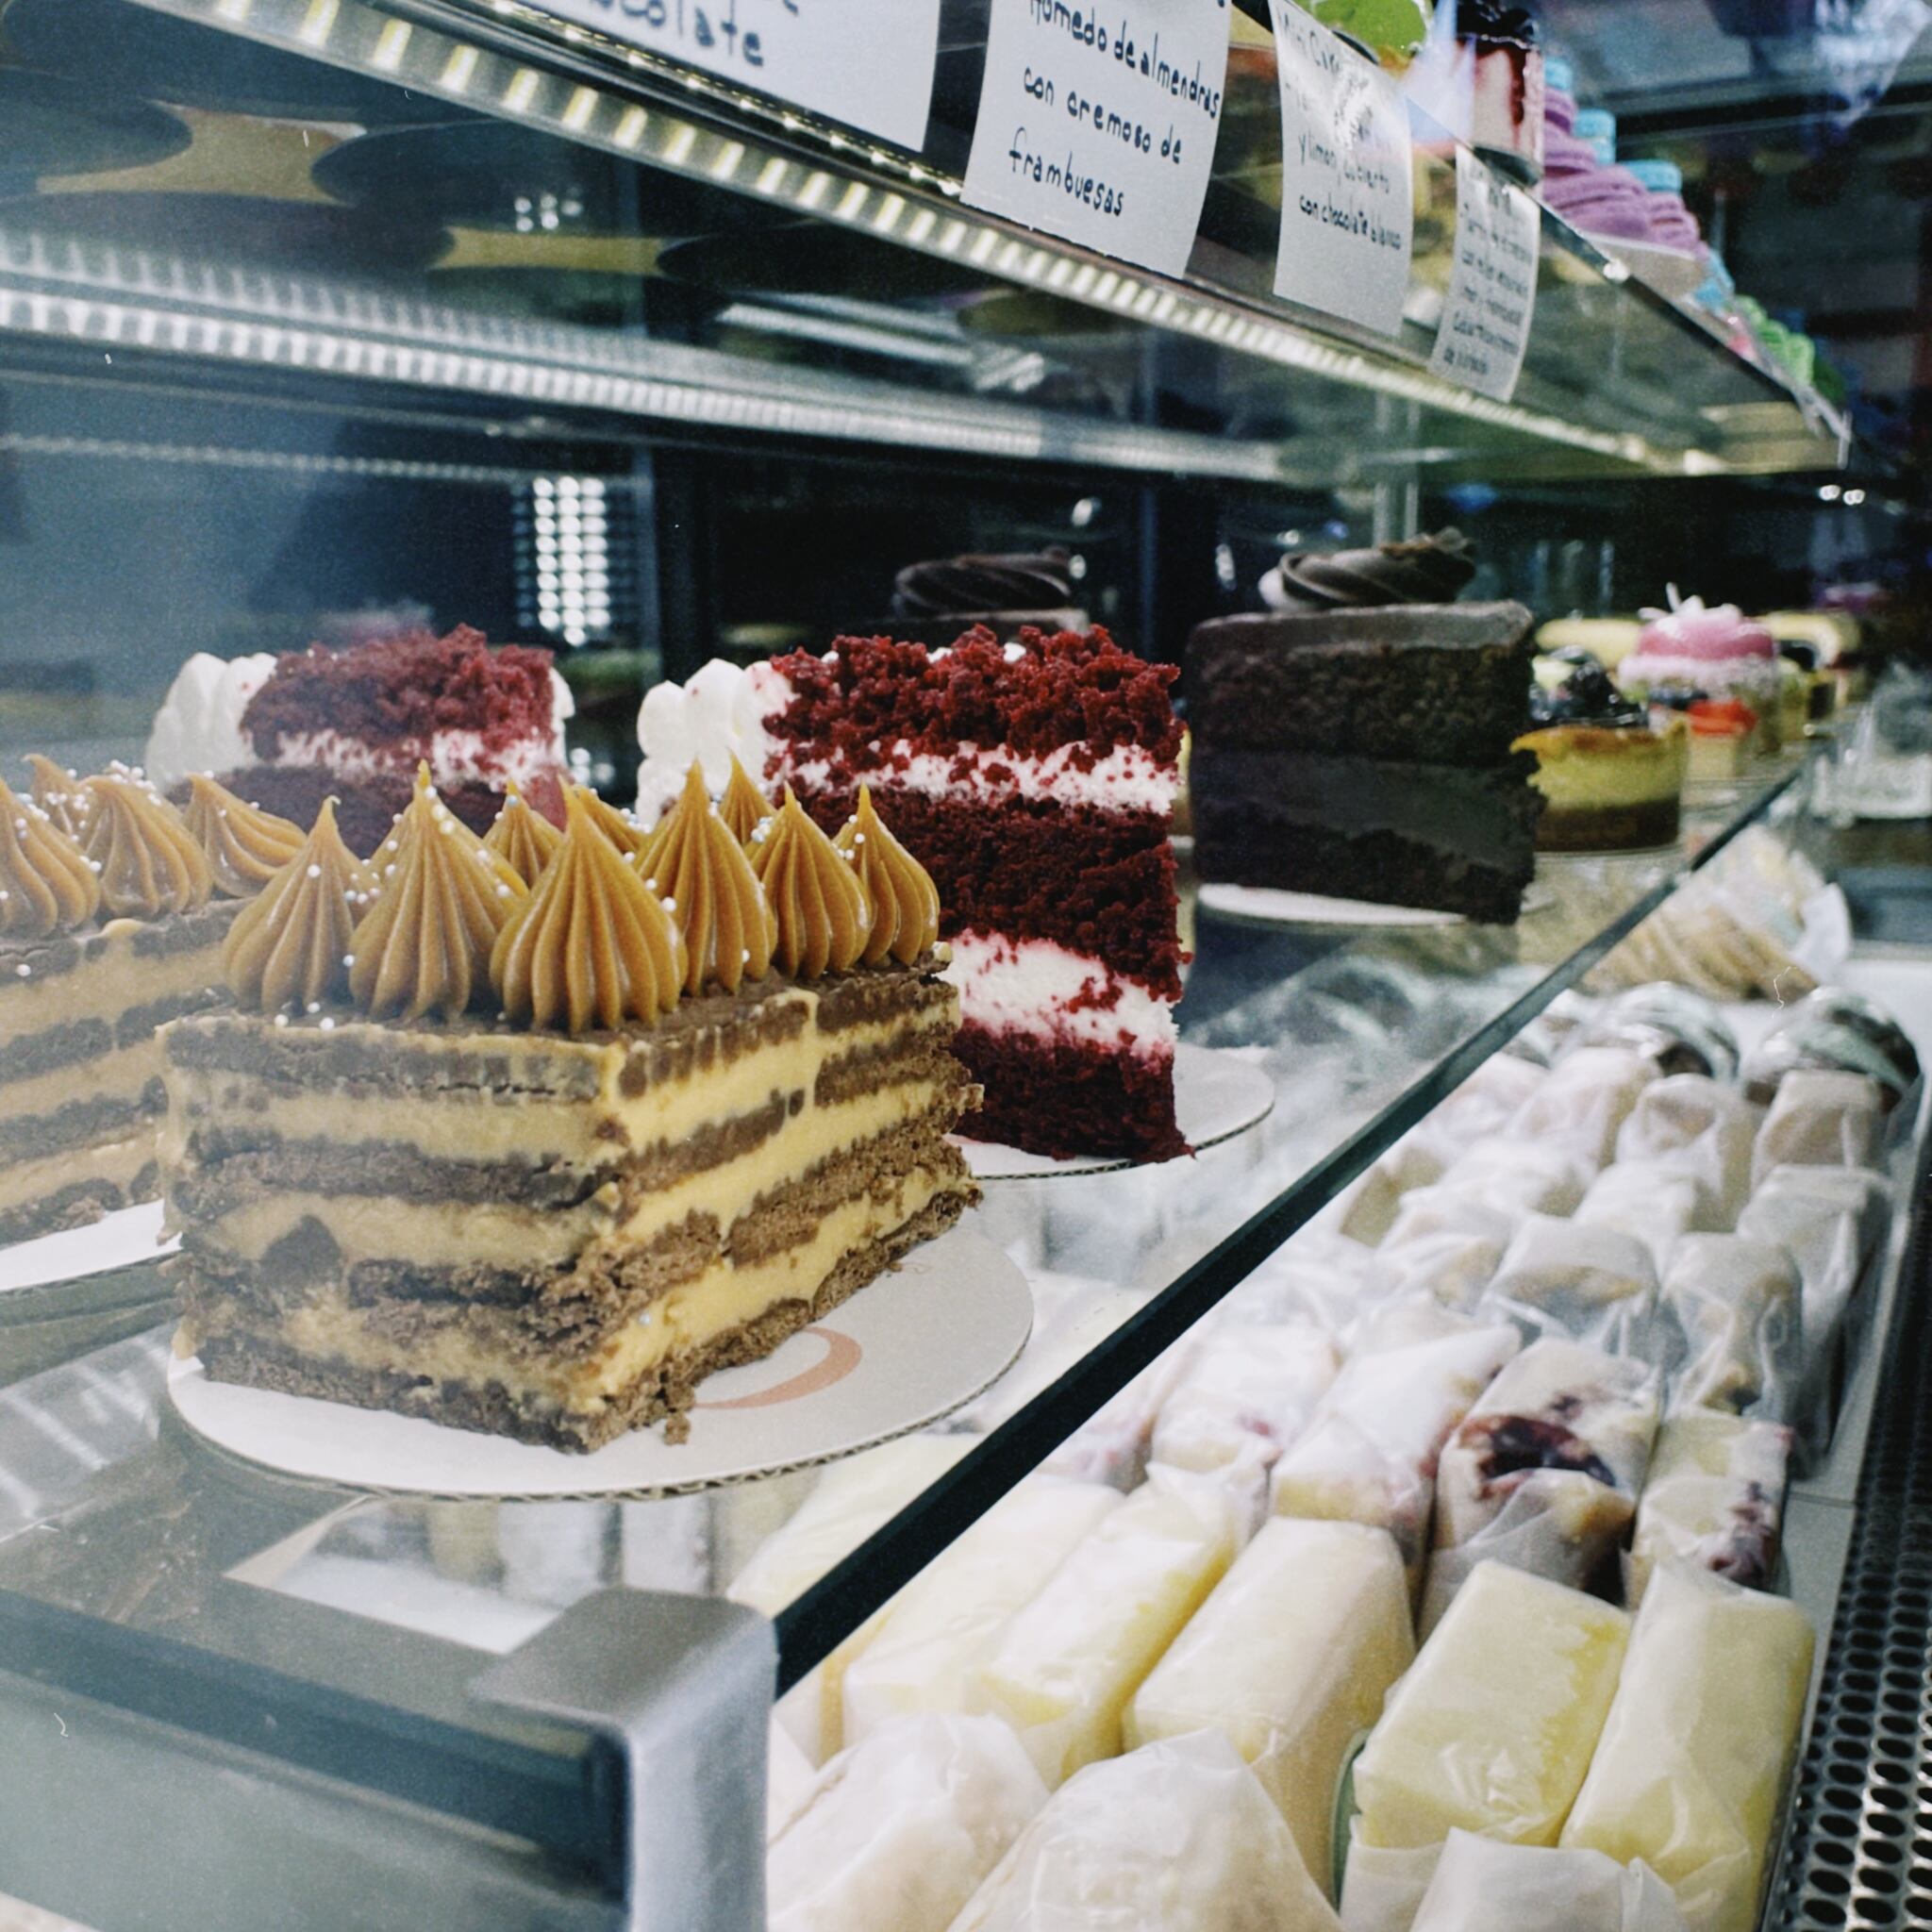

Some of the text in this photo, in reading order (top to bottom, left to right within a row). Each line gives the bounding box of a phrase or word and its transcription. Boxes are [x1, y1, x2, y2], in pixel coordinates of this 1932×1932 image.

[1024, 67, 1182, 164] con cremoso de
[1008, 126, 1124, 217] frambuesas
[1299, 194, 1319, 222] con
[1322, 192, 1369, 237] chocolate
